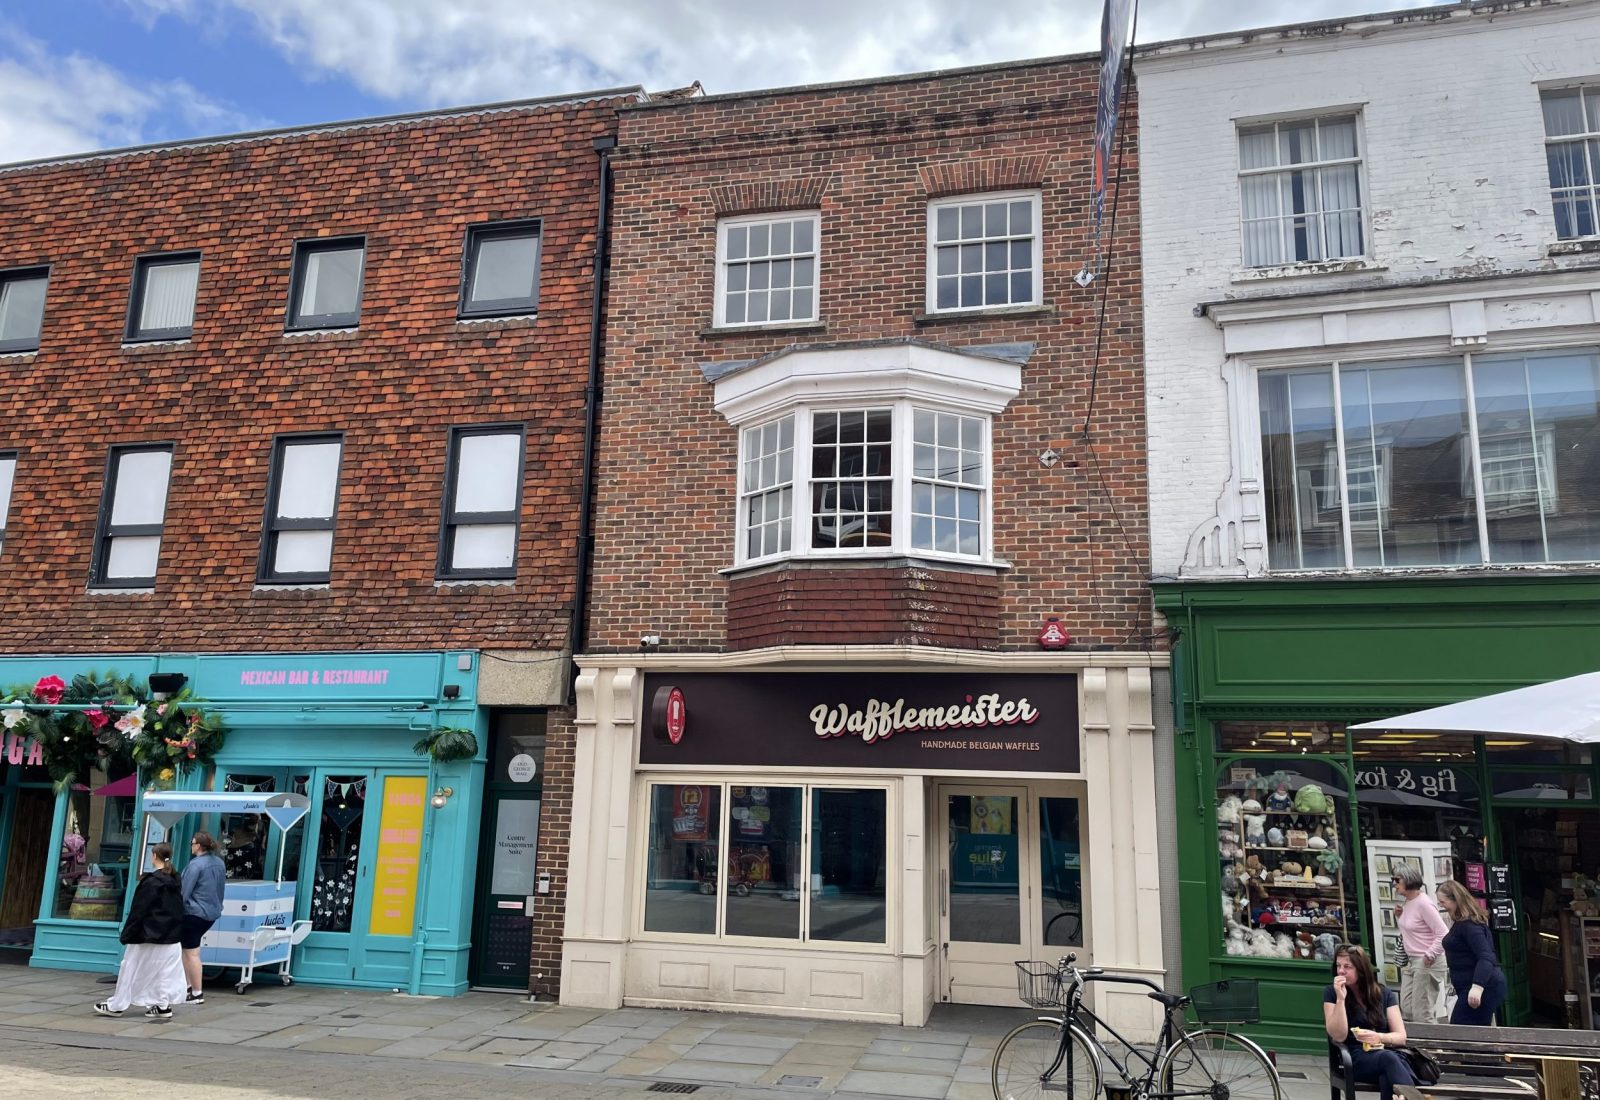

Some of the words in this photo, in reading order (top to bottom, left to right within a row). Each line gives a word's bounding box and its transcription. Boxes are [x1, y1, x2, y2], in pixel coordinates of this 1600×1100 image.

[240, 671, 286, 685] MEXICAN
[288, 671, 309, 685] BAR
[311, 671, 319, 685] &
[323, 669, 389, 685] RESTAURANT
[809, 693, 1039, 744] Wafflemeister
[0, 734, 43, 765] GA
[921, 740, 967, 749] HANDMADE
[969, 741, 1003, 750] BELGIAN
[1005, 741, 1040, 751] WAFFLES
[261, 914, 286, 927] Jude's
